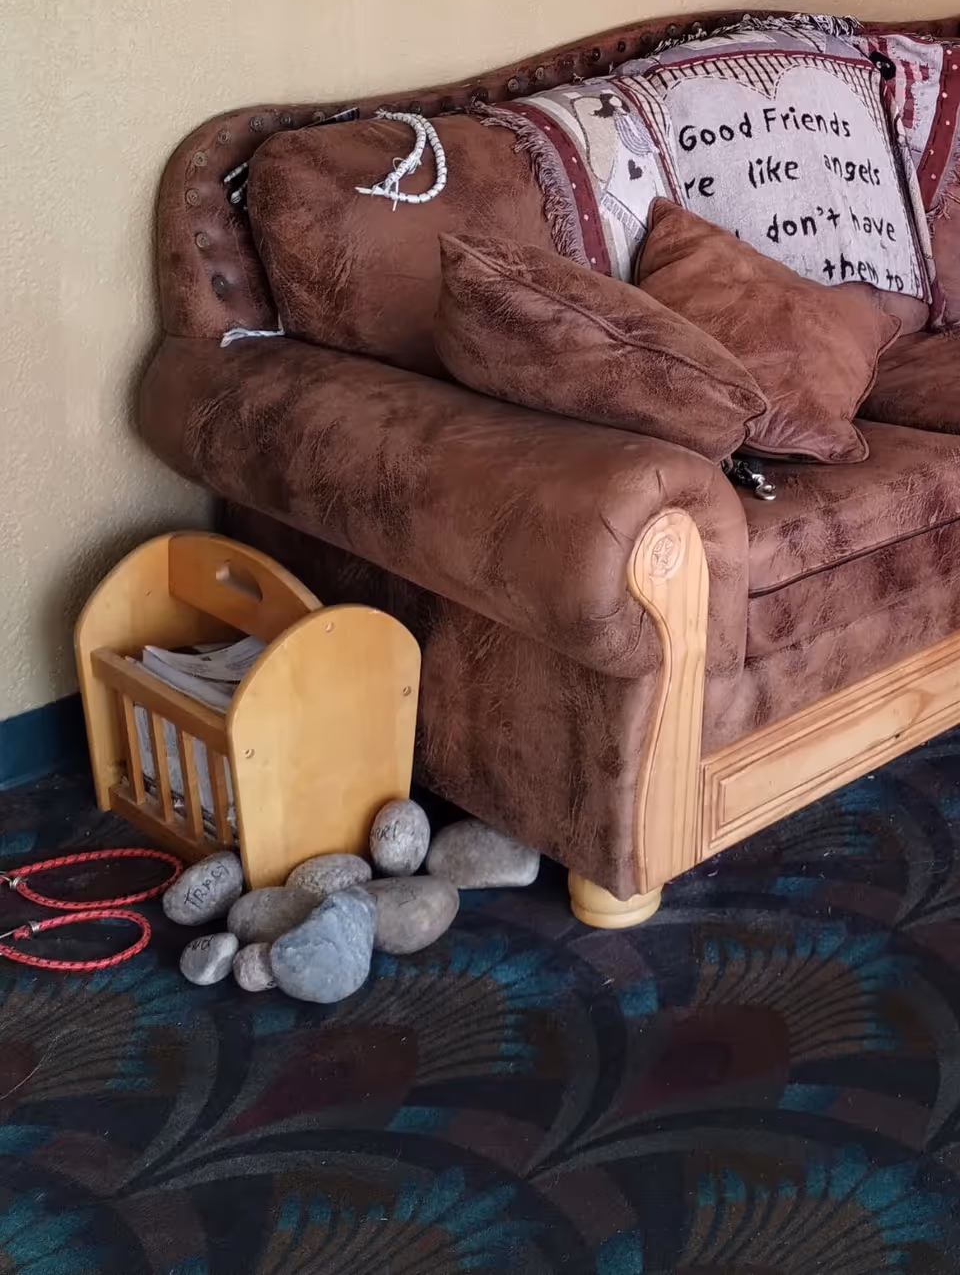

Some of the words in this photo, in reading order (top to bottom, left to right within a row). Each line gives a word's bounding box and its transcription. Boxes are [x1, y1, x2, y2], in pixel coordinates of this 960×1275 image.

[678, 112, 752, 152] Good
[762, 106, 851, 138] Friends
[748, 155, 800, 189] like
[823, 154, 881, 186] angels
[766, 206, 841, 243] don't
[850, 206, 897, 242] have
